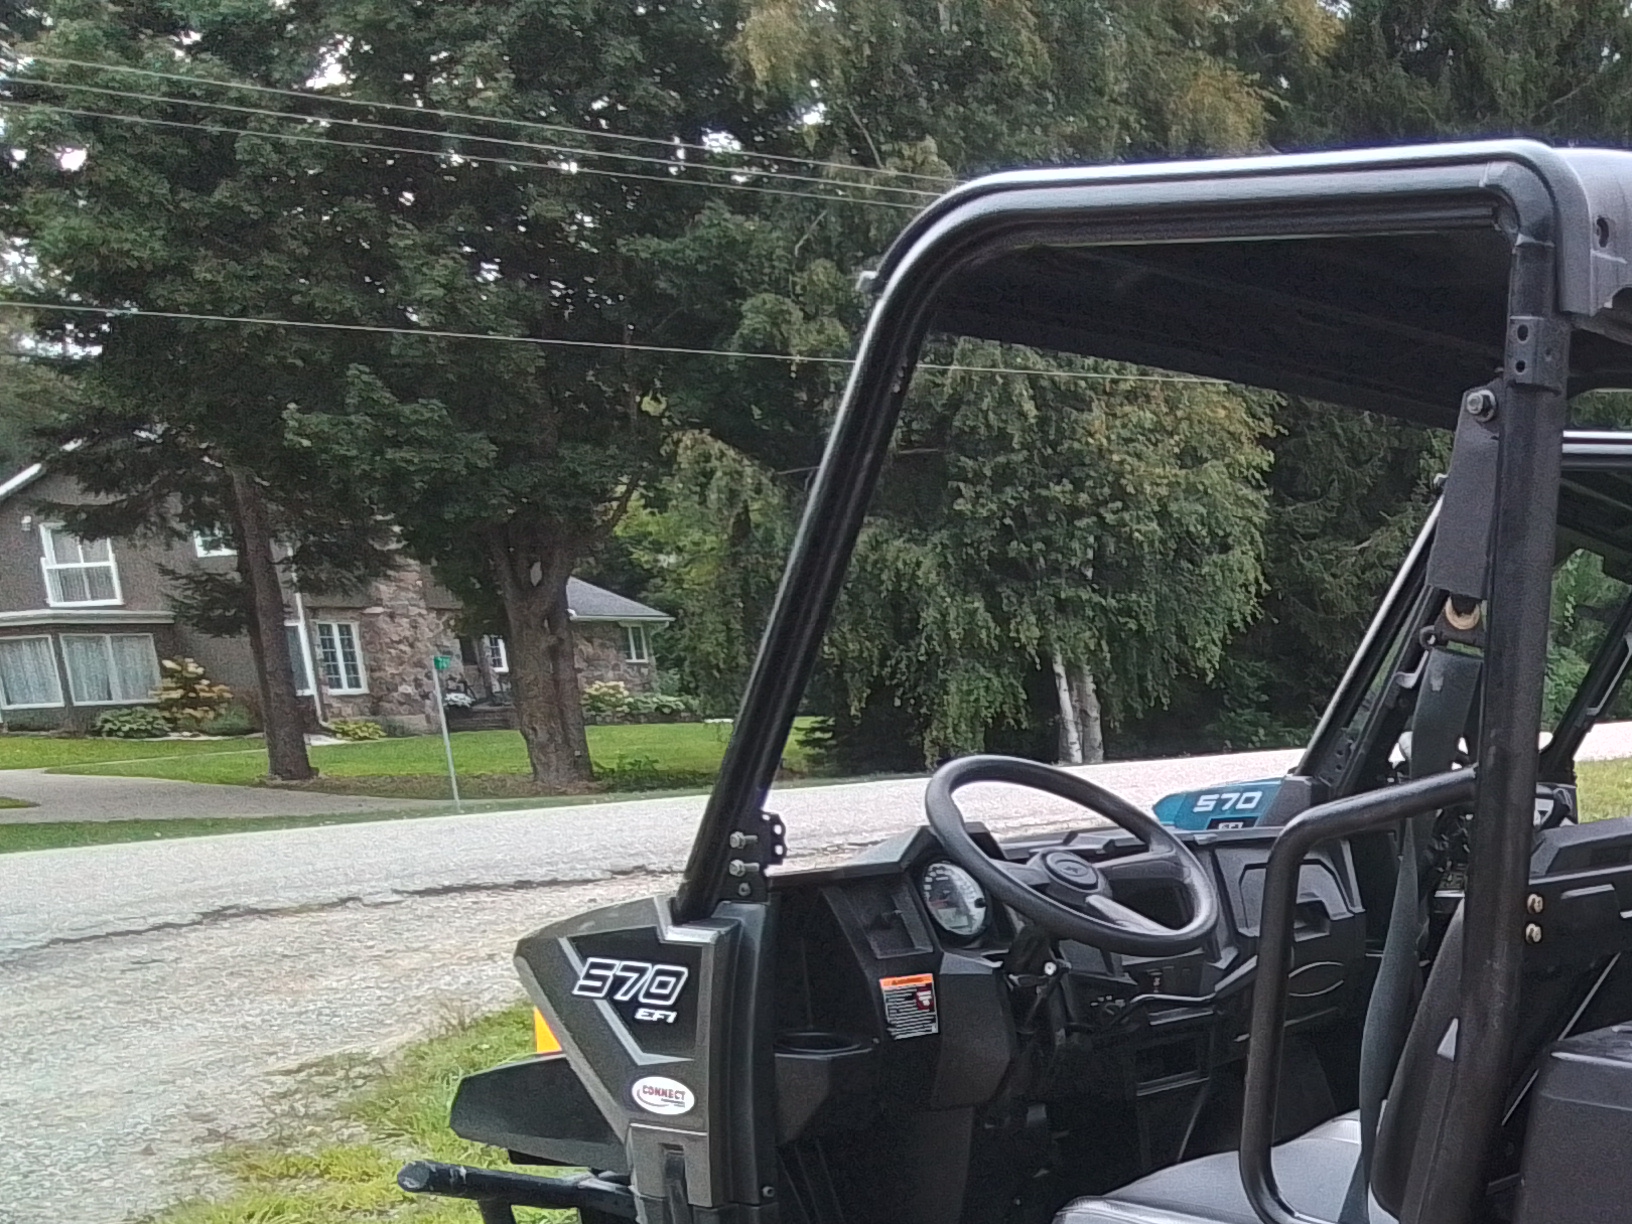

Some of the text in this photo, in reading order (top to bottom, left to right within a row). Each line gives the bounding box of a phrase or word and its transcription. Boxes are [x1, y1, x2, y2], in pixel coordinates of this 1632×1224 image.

[1193, 791, 1263, 813] 570
[572, 957, 689, 1005] 570
[634, 1008, 678, 1024] EFI
[642, 1084, 686, 1101] CONNECT
